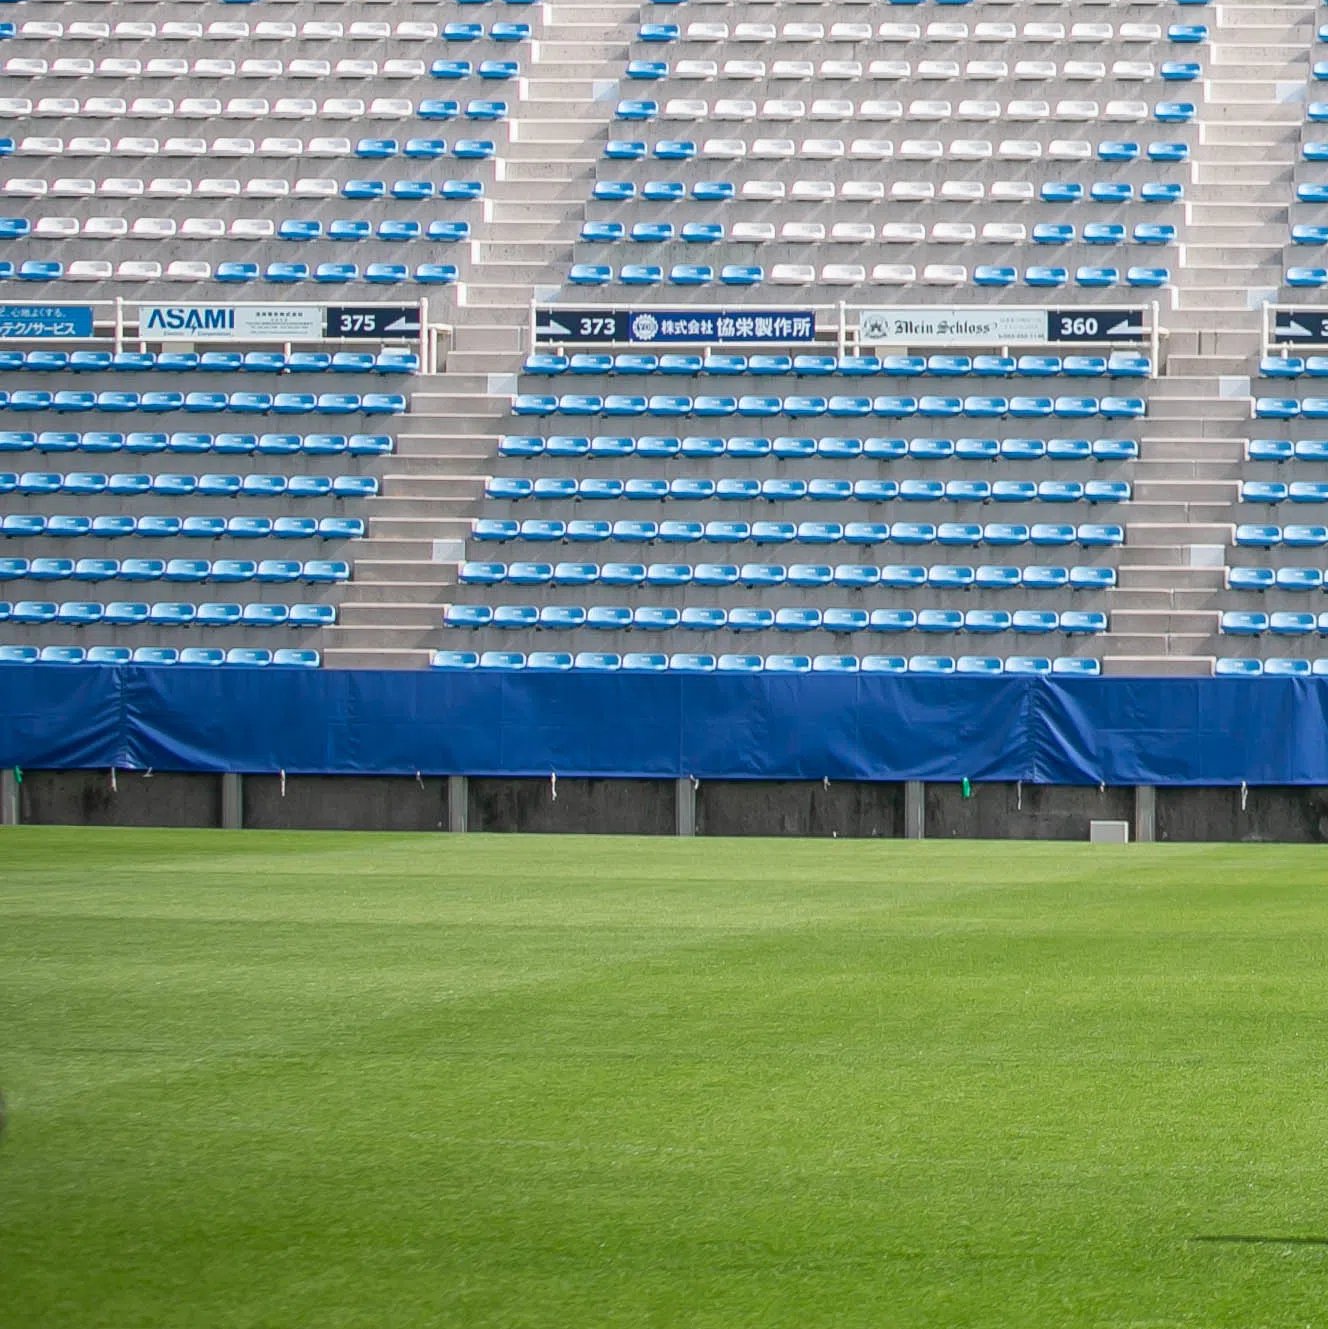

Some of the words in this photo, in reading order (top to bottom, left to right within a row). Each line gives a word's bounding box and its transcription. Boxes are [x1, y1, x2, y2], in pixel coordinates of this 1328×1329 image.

[147, 309, 235, 330] ASAMI
[341, 315, 375, 331] 375
[581, 318, 615, 335] 373
[661, 319, 713, 335] 株式会社
[716, 316, 811, 338] 協栄製作所
[895, 320, 933, 333] Mein
[937, 321, 990, 334] Schloss
[1061, 318, 1098, 335] 360
